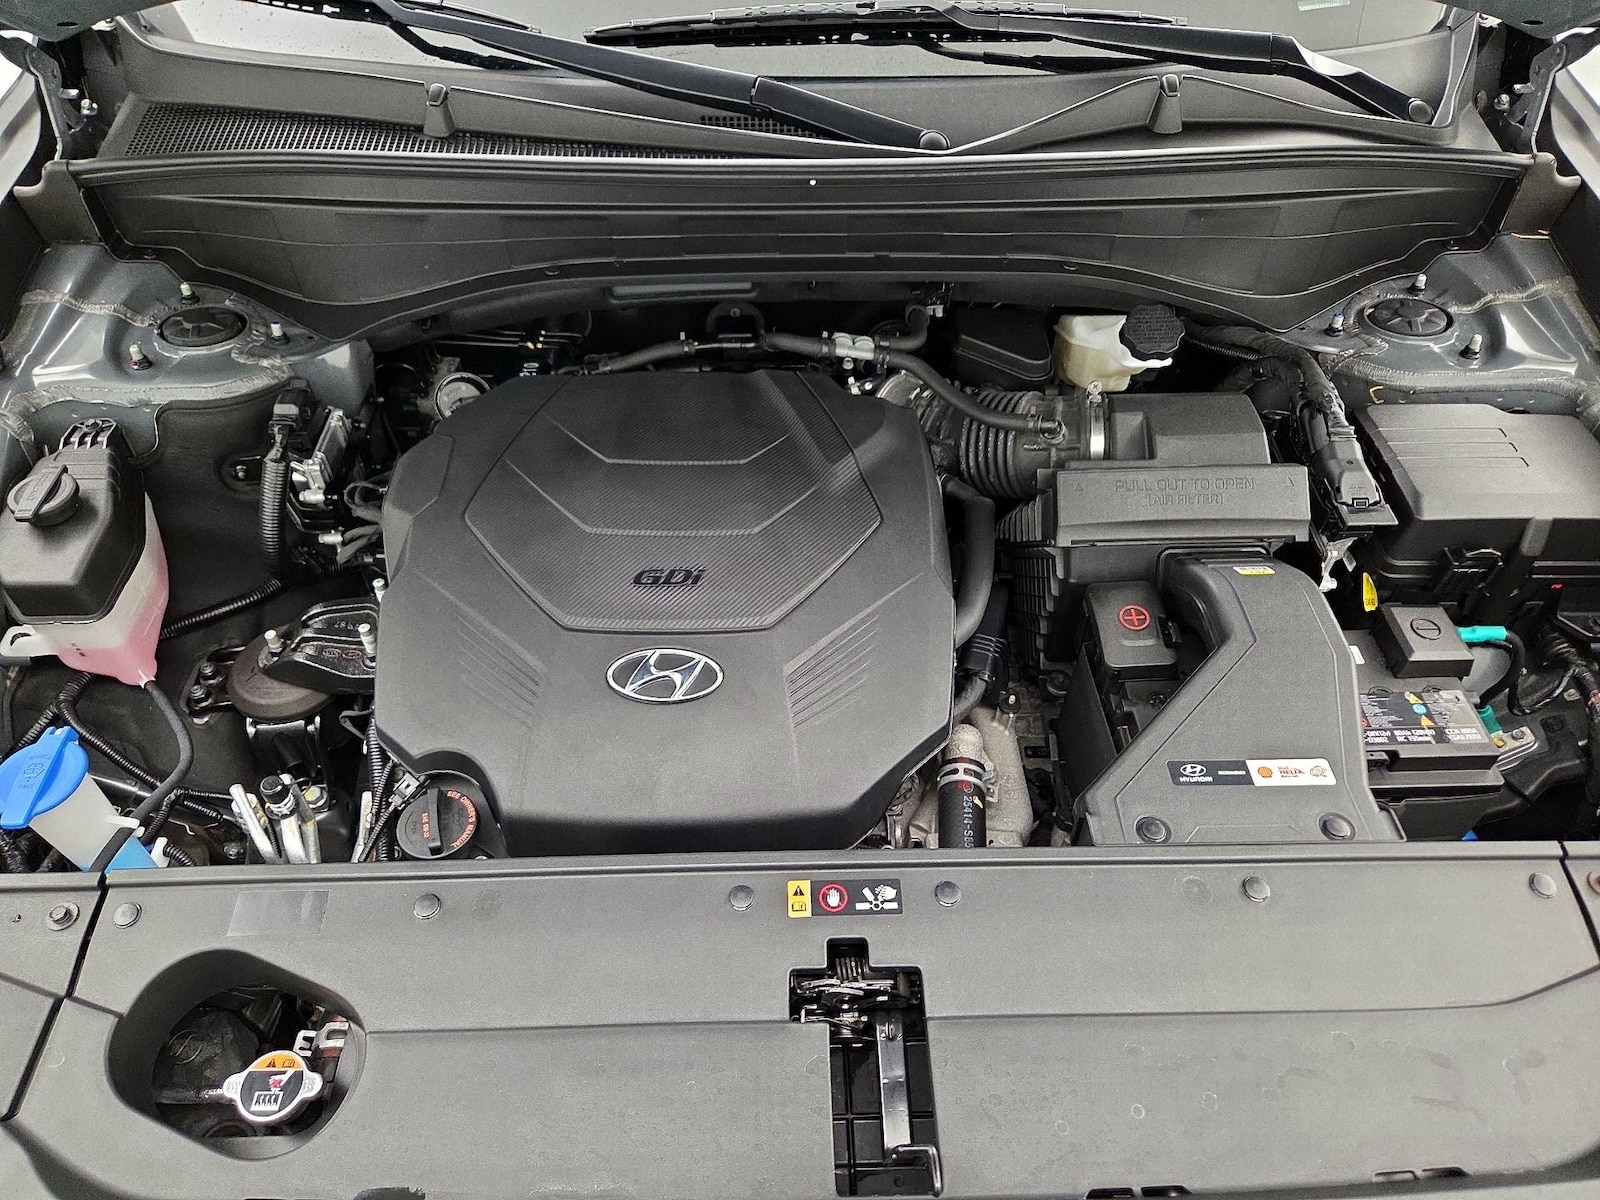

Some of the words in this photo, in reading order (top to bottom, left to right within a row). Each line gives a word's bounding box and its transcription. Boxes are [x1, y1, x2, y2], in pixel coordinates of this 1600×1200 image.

[1114, 480, 1150, 492] PULL
[1156, 479, 1186, 491] OUT
[1191, 479, 1210, 490] TO
[1215, 478, 1255, 489] OPEN
[447, 790, 461, 799] SEE
